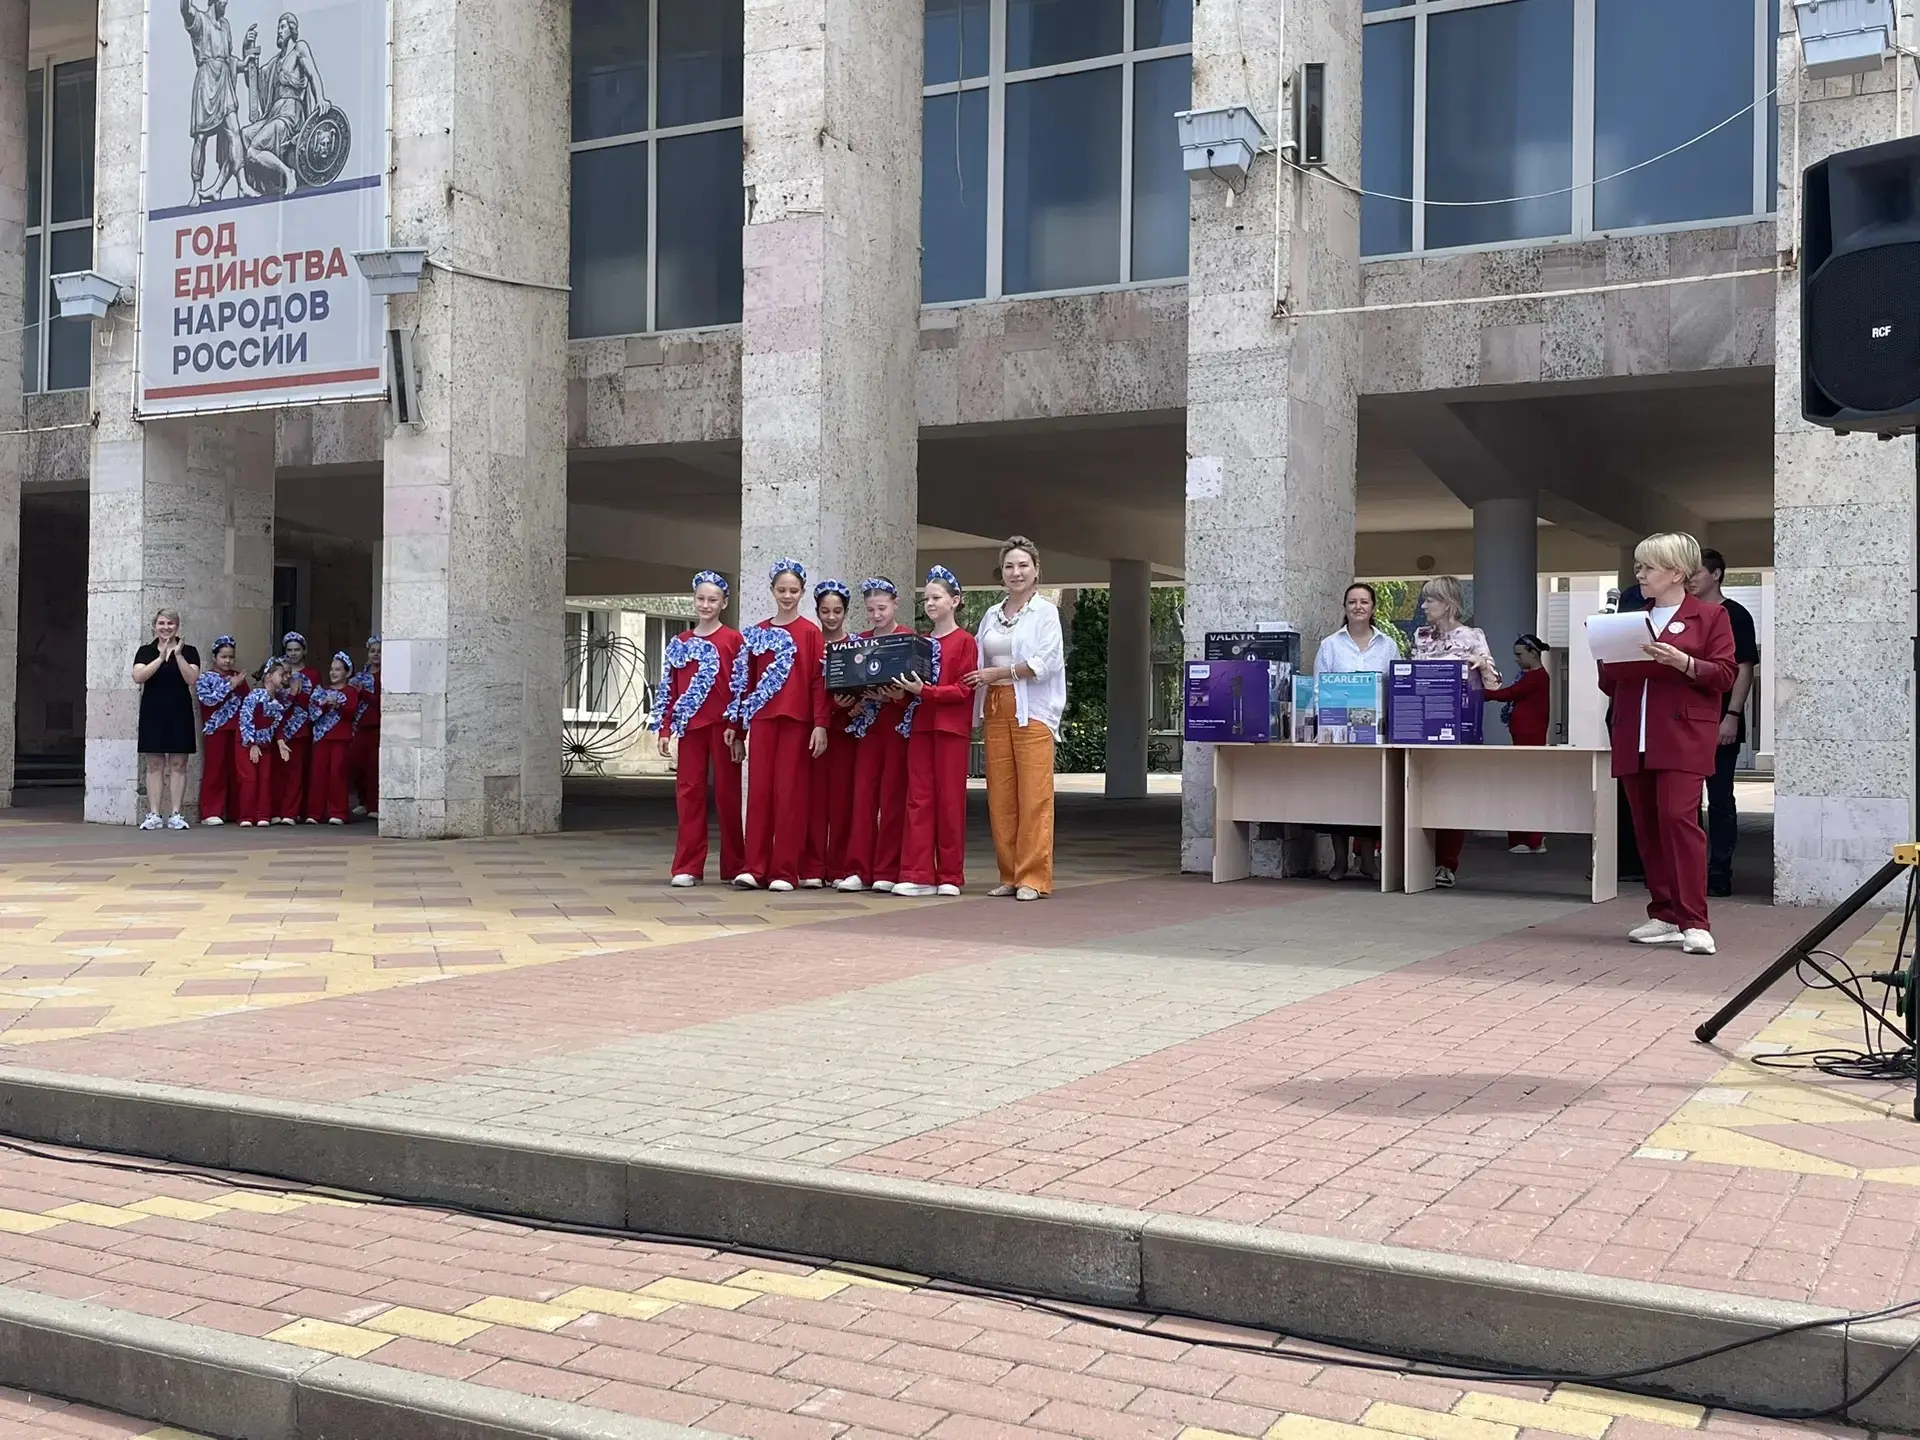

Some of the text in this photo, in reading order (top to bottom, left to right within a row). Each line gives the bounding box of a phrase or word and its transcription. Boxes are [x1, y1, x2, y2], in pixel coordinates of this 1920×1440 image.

[175, 222, 237, 259] ГОД
[174, 247, 348, 301] ЕДИНСТВА
[173, 290, 330, 337] НАРОДОВ
[1872, 325, 1891, 338] RCF
[172, 332, 308, 375] РОССИИ
[1321, 675, 1370, 684] SCARLETT
